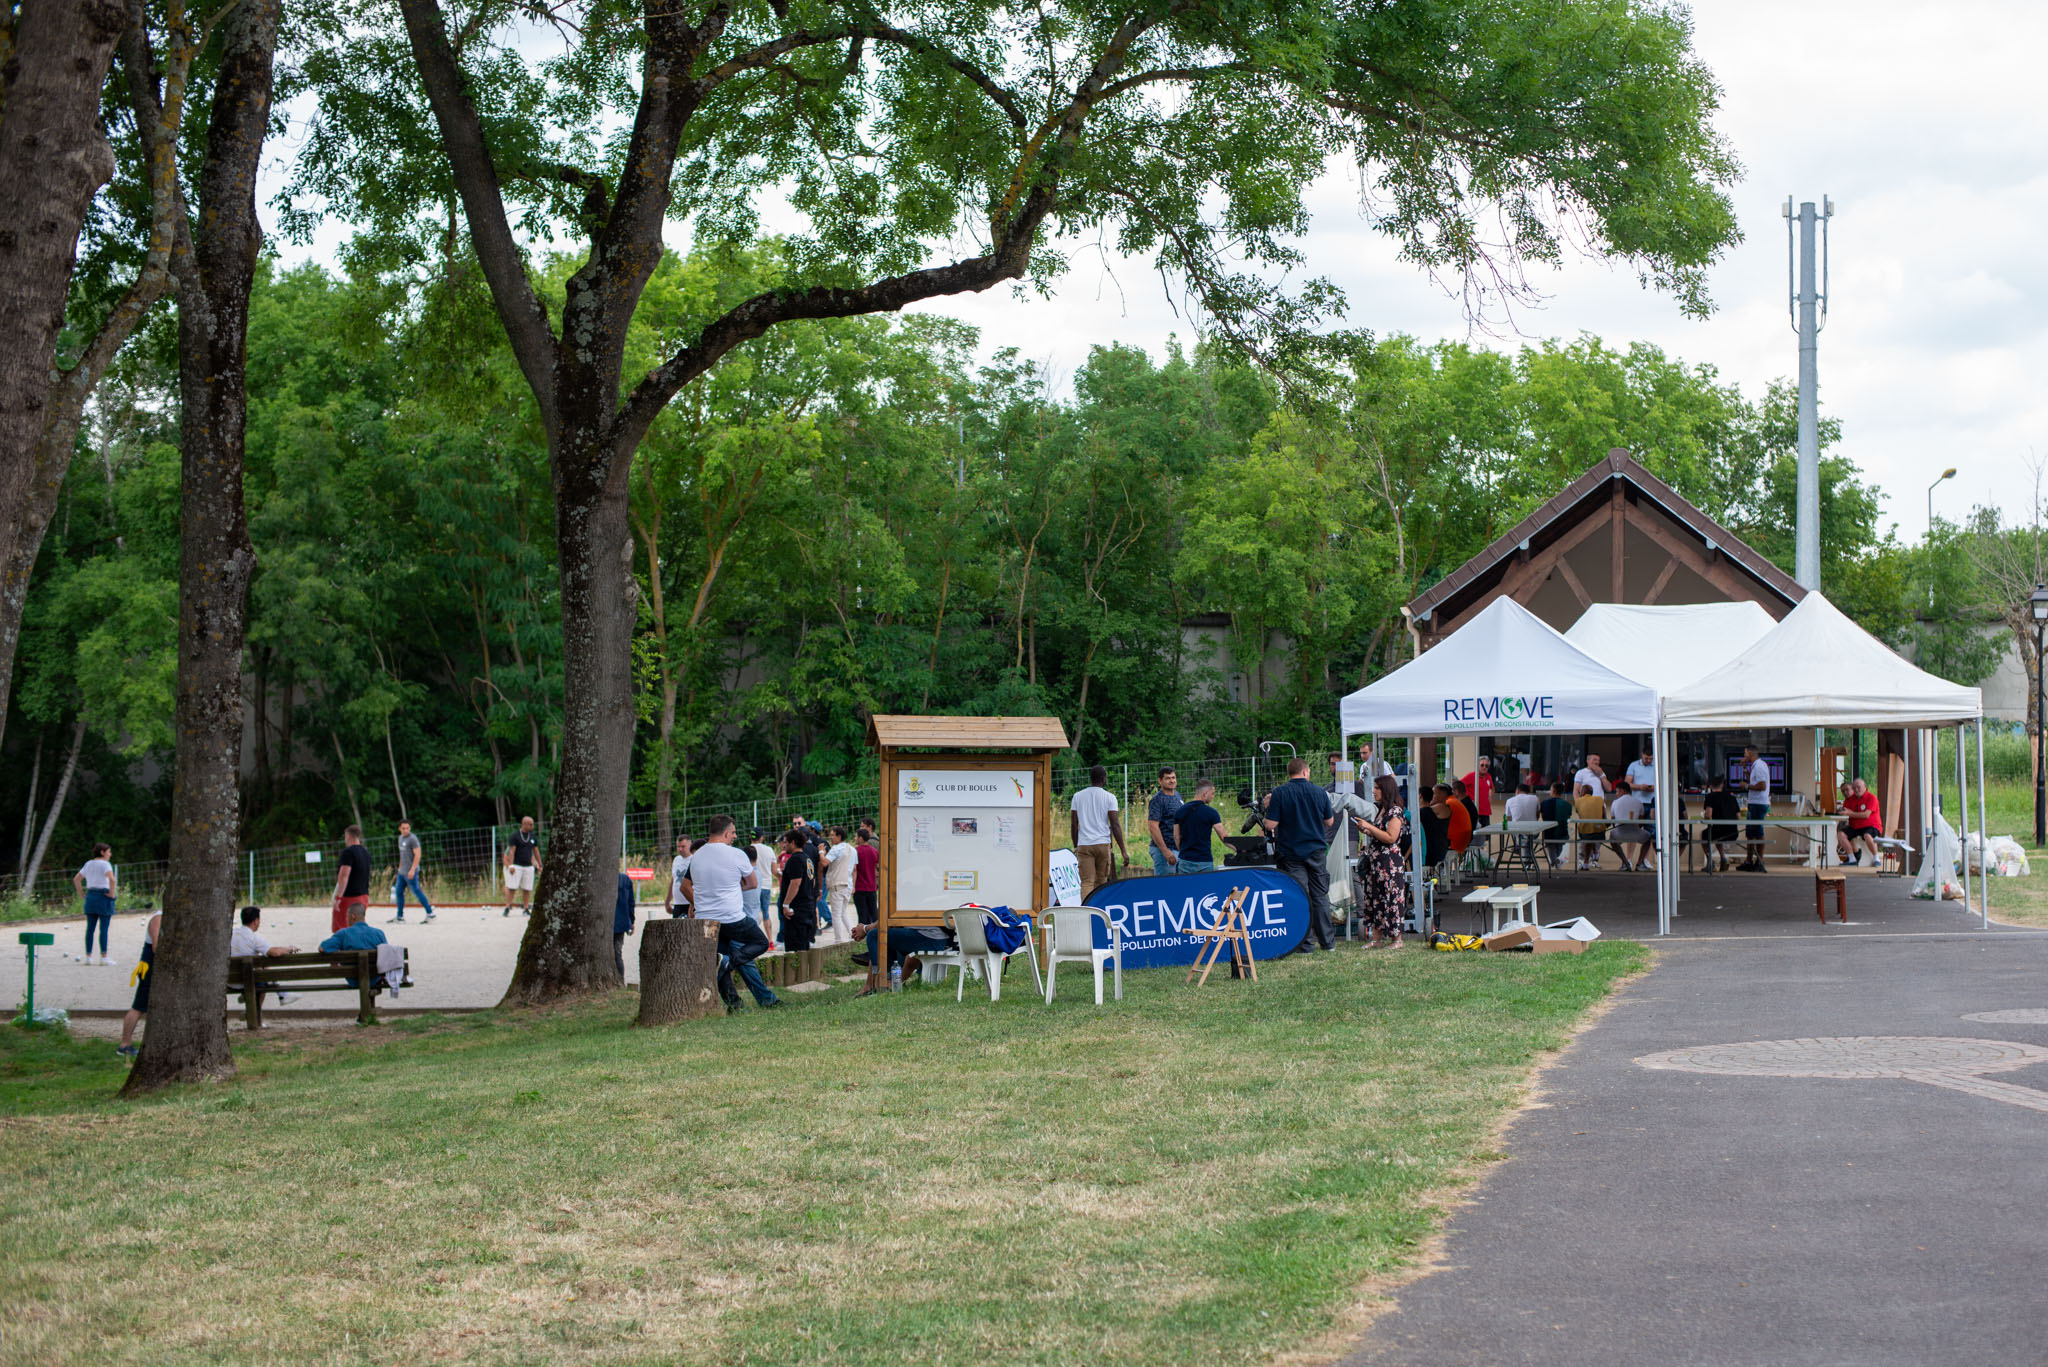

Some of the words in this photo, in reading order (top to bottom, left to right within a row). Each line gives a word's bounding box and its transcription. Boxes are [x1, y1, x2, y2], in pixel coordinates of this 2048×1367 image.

[1444, 696, 1554, 721] REMOVE
[1444, 721, 1490, 729] DEPOLLUTION
[935, 784, 956, 792] CLUB
[957, 784, 967, 792] DE
[968, 784, 998, 792] BOULES
[1104, 889, 1286, 940] REMOVE
[1107, 936, 1182, 952] DPOLLUTION
[1189, 927, 1287, 945] DEOUCTION
